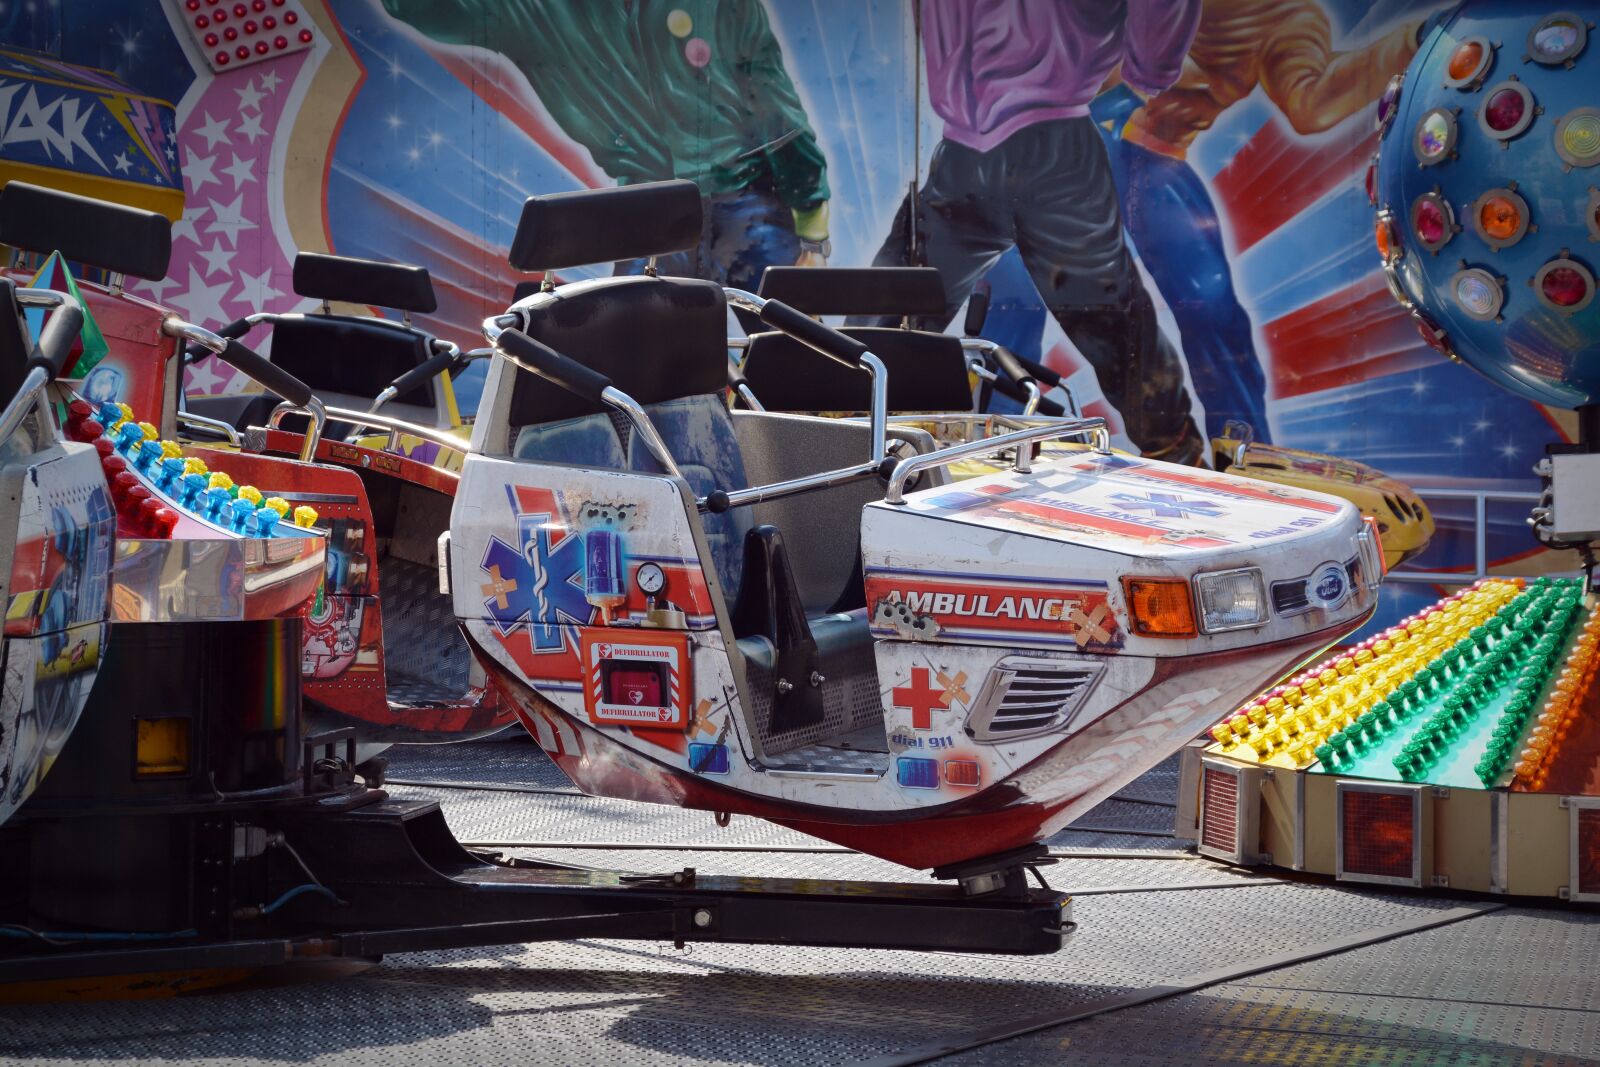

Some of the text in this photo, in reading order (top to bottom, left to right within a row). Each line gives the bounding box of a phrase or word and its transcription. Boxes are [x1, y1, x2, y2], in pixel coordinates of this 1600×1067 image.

[883, 590, 1083, 622] AMBULANCE
[614, 648, 670, 658] DEFIBRILLATOR
[601, 708, 657, 718] DEFIBRILLATOR
[929, 735, 954, 748] 911
